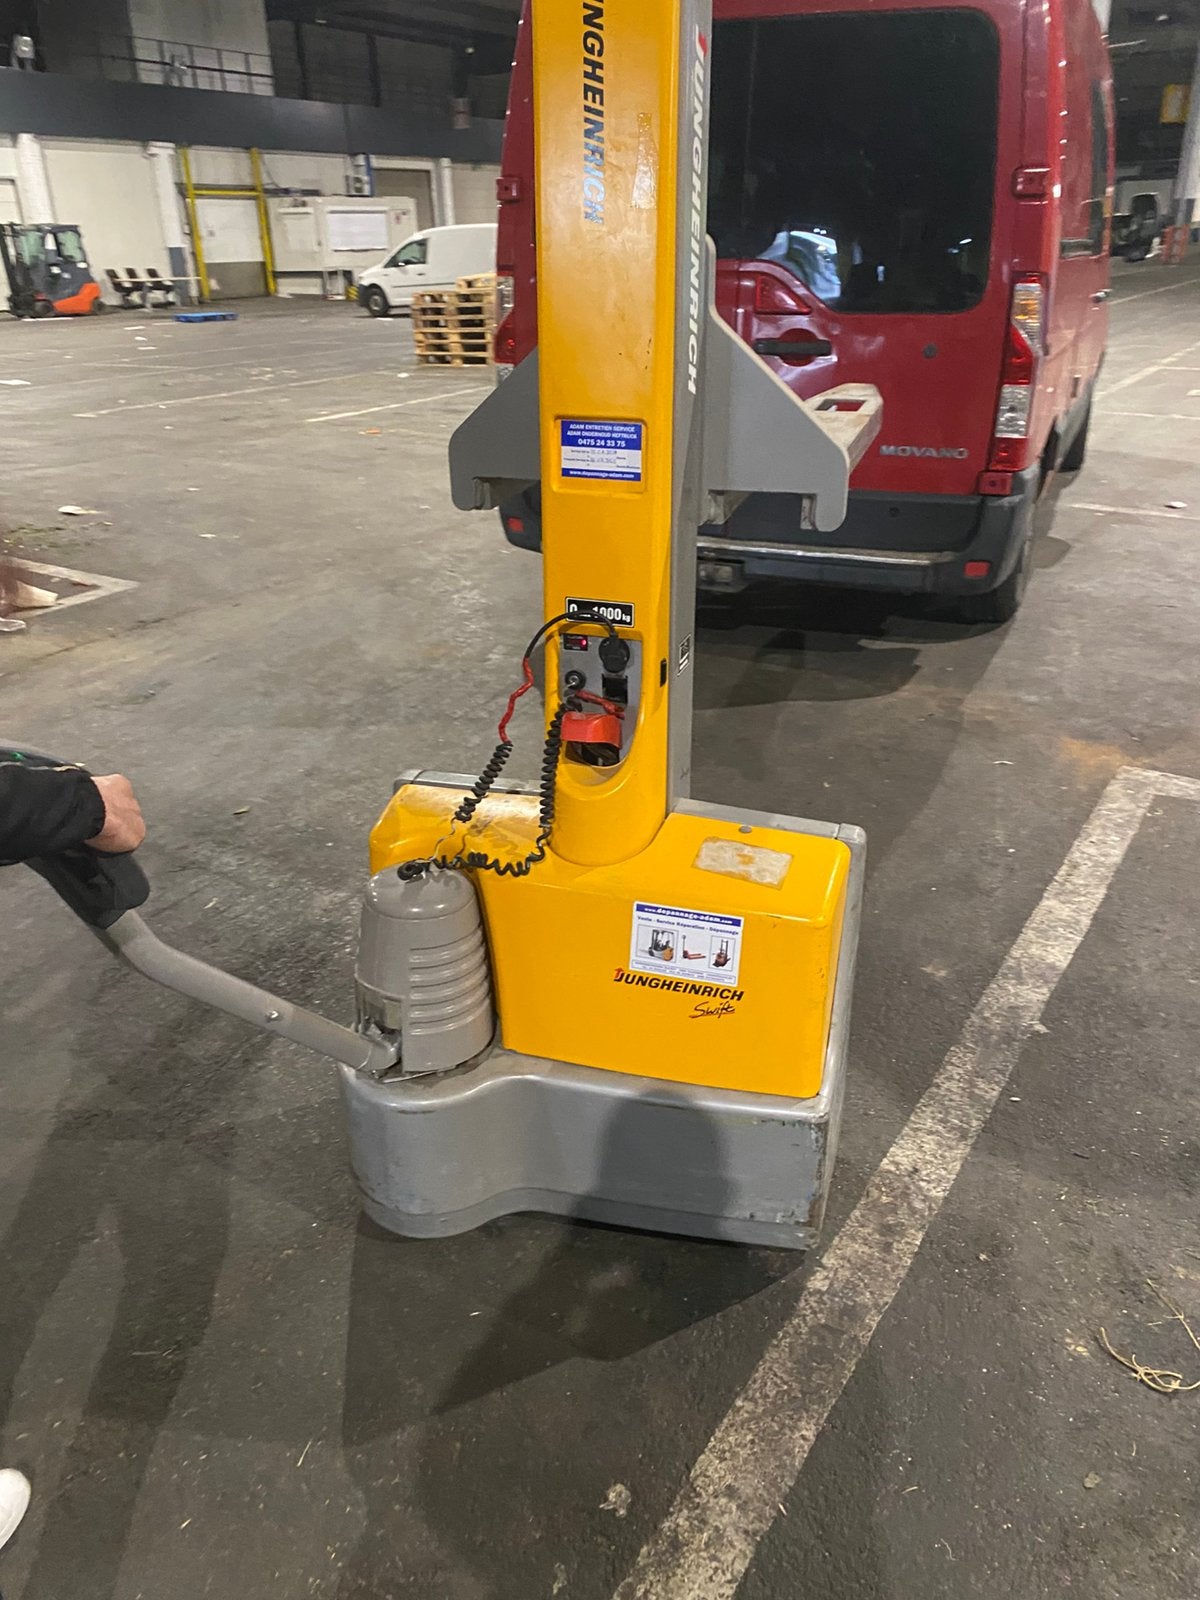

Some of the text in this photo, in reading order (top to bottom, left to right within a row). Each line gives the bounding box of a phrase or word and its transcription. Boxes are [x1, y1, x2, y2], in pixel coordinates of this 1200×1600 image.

[582, 0, 605, 224] NGHEINRICH
[688, 24, 709, 395] JUNGHEINRICH
[577, 438, 595, 446] 0475
[606, 439, 615, 447] 33
[879, 445, 969, 460] MOVANO
[644, 907, 733, 924] www.depannage-adam.com
[614, 968, 745, 1001] JUNGHEINRICH
[689, 1001, 736, 1019] Swift
